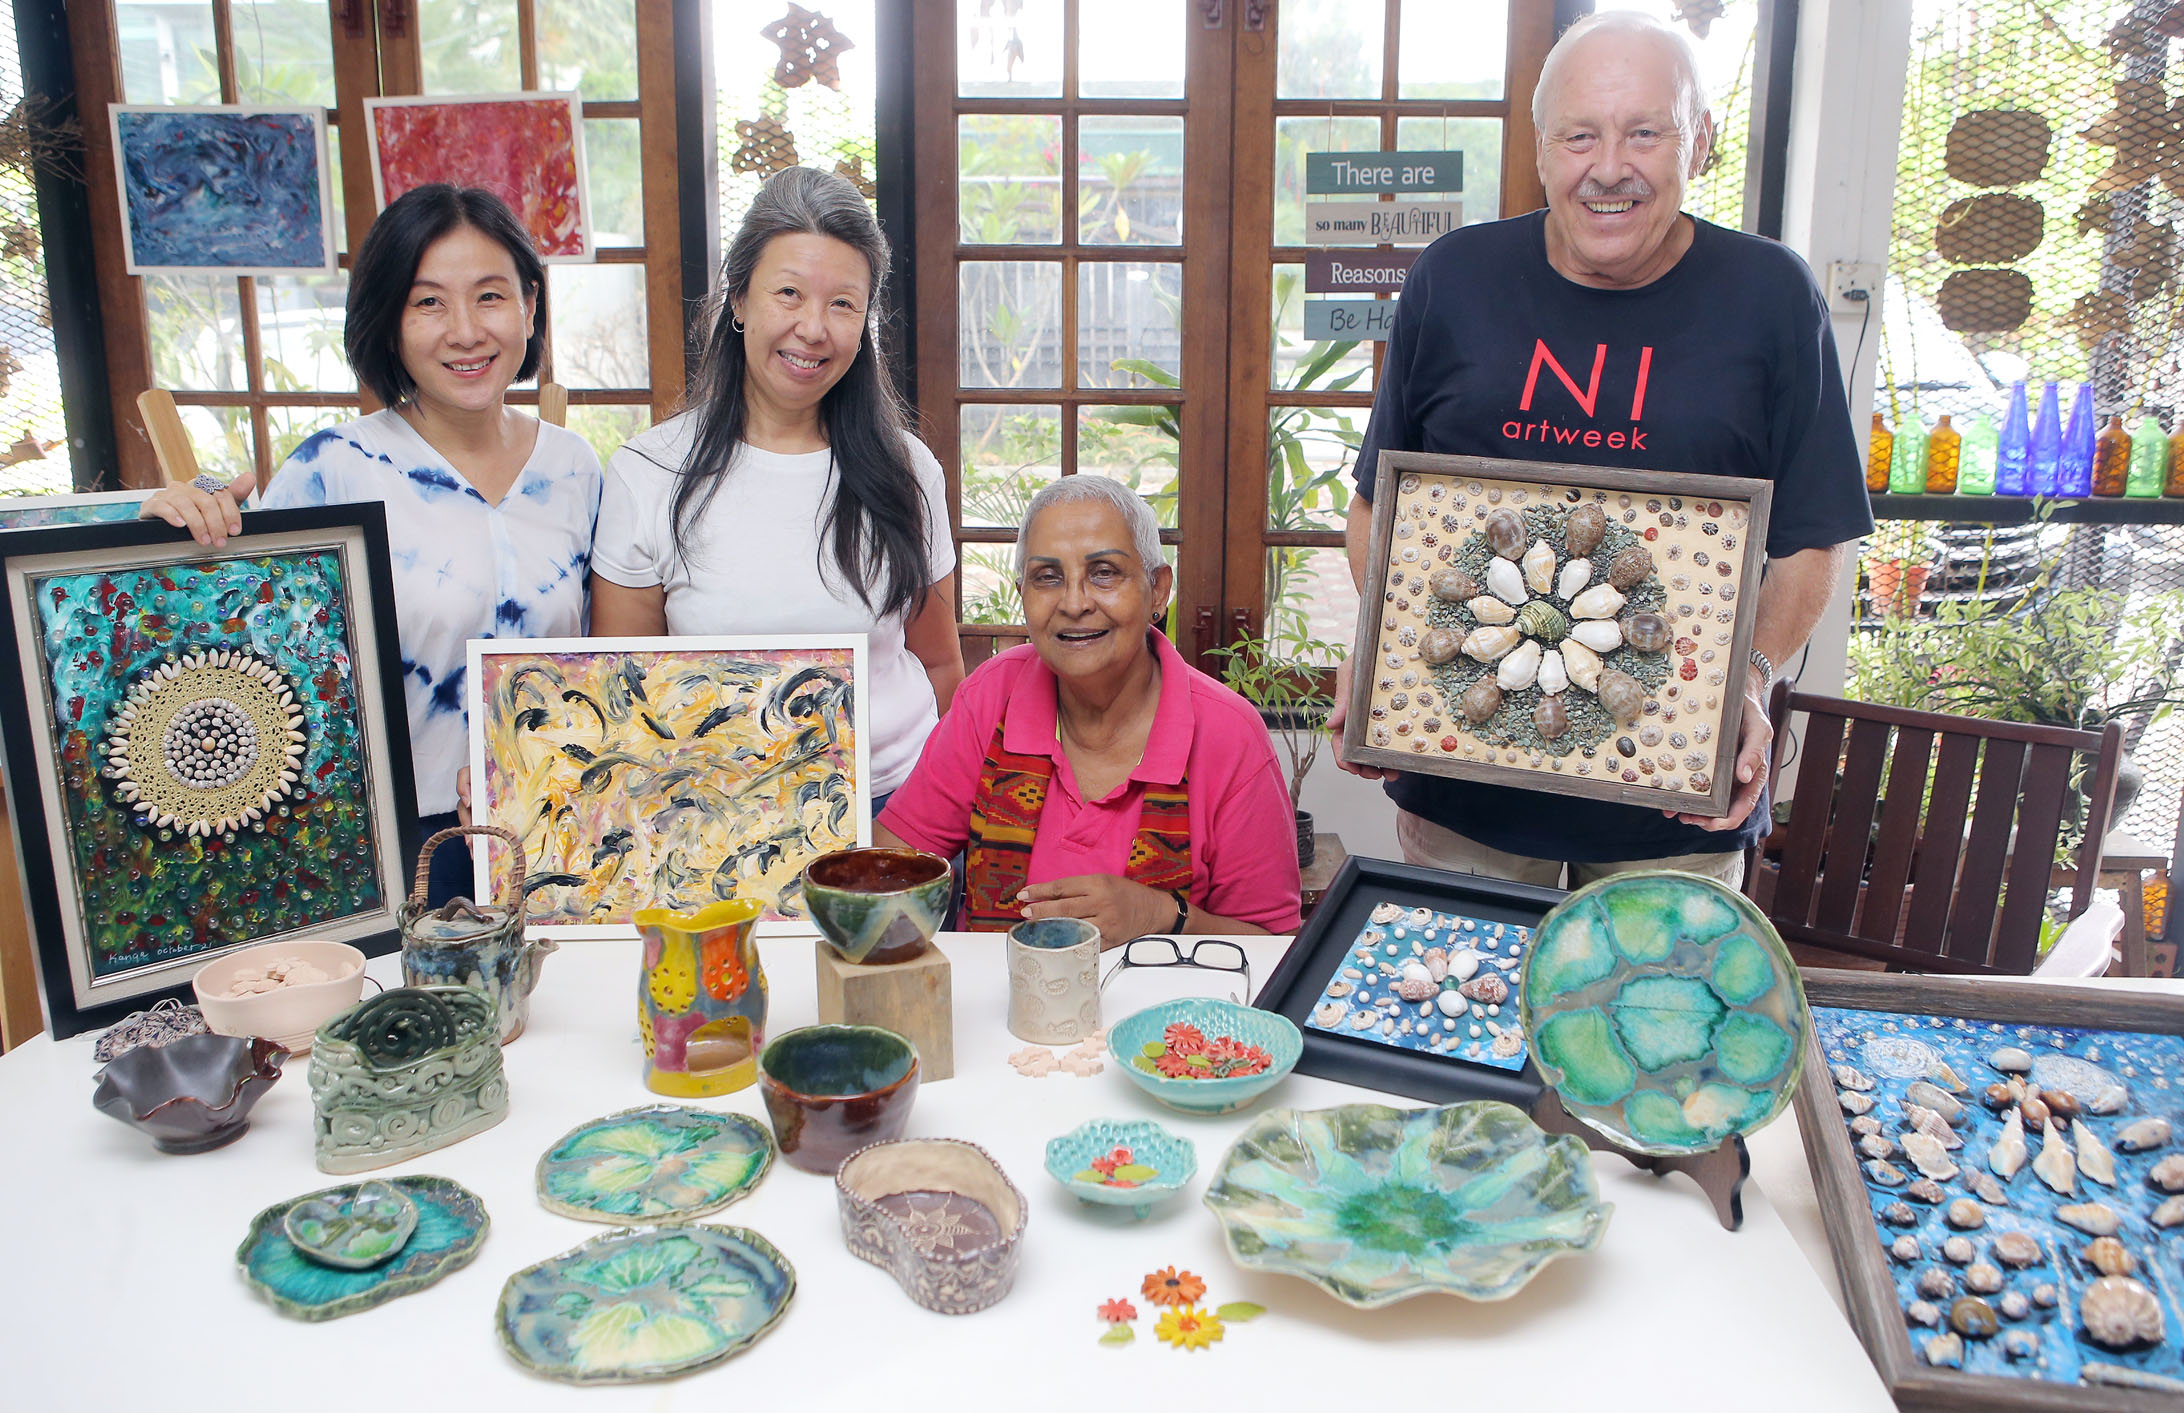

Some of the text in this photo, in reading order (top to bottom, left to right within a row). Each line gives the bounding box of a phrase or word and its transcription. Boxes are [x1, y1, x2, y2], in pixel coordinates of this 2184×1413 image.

[1331, 160, 1435, 185] There are
[1315, 220, 1330, 231] so
[1335, 218, 1368, 234] many
[1331, 262, 1407, 284] Reasons
[1330, 308, 1361, 331] Be
[1519, 338, 1653, 421] NI
[1502, 420, 1648, 450] artweek
